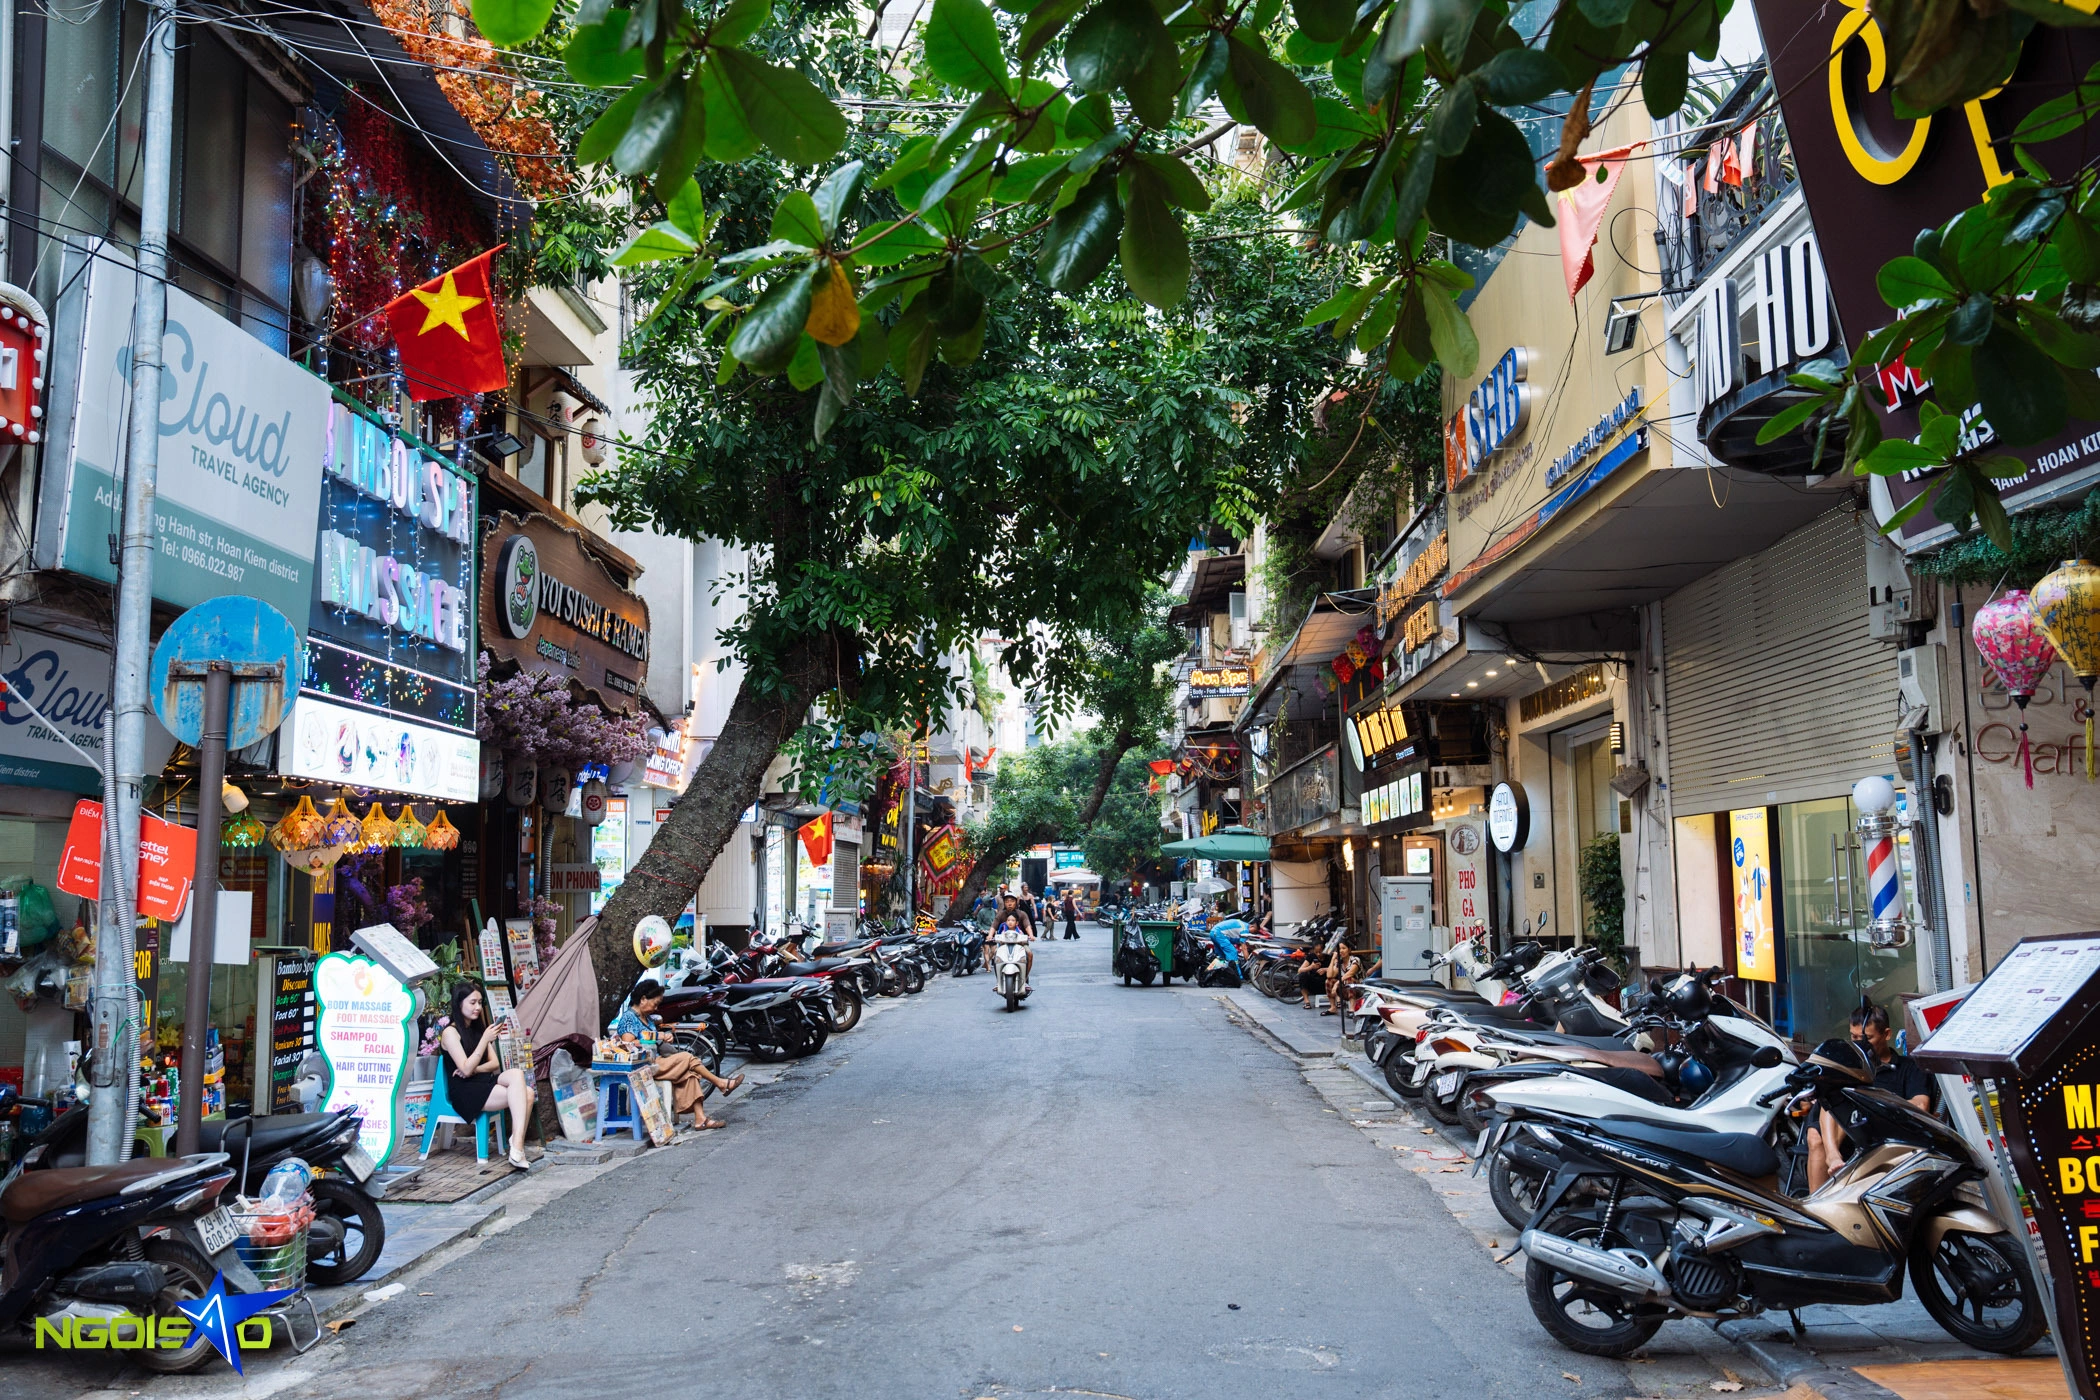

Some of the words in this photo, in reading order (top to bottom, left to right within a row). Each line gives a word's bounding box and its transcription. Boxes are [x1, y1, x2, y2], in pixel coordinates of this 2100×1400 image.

[1469, 346, 1531, 470] SHB
[2037, 441, 2080, 475] HOAN
[191, 445, 238, 485] TRAVEL
[242, 473, 290, 509] AGENCY
[421, 461, 470, 545] SPA
[160, 535, 180, 559] Tel:
[181, 544, 245, 583] 0966.022.987
[168, 515, 197, 542] Hanh
[198, 530, 215, 552] str,
[216, 534, 242, 561] Hoan
[243, 547, 268, 571] Kiem
[268, 558, 300, 584] district
[321, 530, 466, 653] MASSAGE
[540, 571, 564, 619] YOI
[564, 585, 601, 638] SUSHI
[600, 608, 613, 643] &
[611, 614, 651, 662] RAMEN
[1191, 670, 1220, 687] Mon
[1220, 668, 1248, 688] Spa
[0, 649, 108, 730] Clou
[69, 732, 105, 751] AGENC
[1976, 722, 2100, 776] Craf
[14, 764, 40, 779] district
[138, 850, 169, 867] oney
[139, 840, 169, 857] ettel
[1070, 853, 1085, 861] ATM
[565, 865, 600, 891] PHÒNG
[1458, 862, 1476, 891] PHỞ
[145, 894, 169, 906] INTERNET
[1461, 892, 1476, 918] GÀ
[134, 950, 152, 980] FOR
[277, 958, 303, 977] Bamboo
[303, 957, 316, 977] Spa
[282, 977, 309, 992] Discount
[274, 1008, 288, 1021] Foot
[327, 999, 349, 1011] BODY
[351, 1000, 392, 1012] MASSAGE
[336, 1012, 357, 1023] FOOT
[359, 1013, 401, 1025] MASSAGE
[330, 1031, 378, 1043] SHAMPOO
[363, 1043, 397, 1055] FACIAL
[273, 1053, 291, 1067] Facial
[335, 1061, 355, 1072] HAIR
[357, 1061, 392, 1074] CUTTING
[357, 1074, 377, 1085] HAIR
[378, 1074, 394, 1085] DYE
[2062, 1083, 2100, 1130] M
[360, 1119, 389, 1130] ASHES
[359, 1136, 378, 1147] EAN
[366, 1149, 382, 1160] AVE
[200, 1208, 228, 1235] 29-H1
[205, 1221, 238, 1252] 808.51
